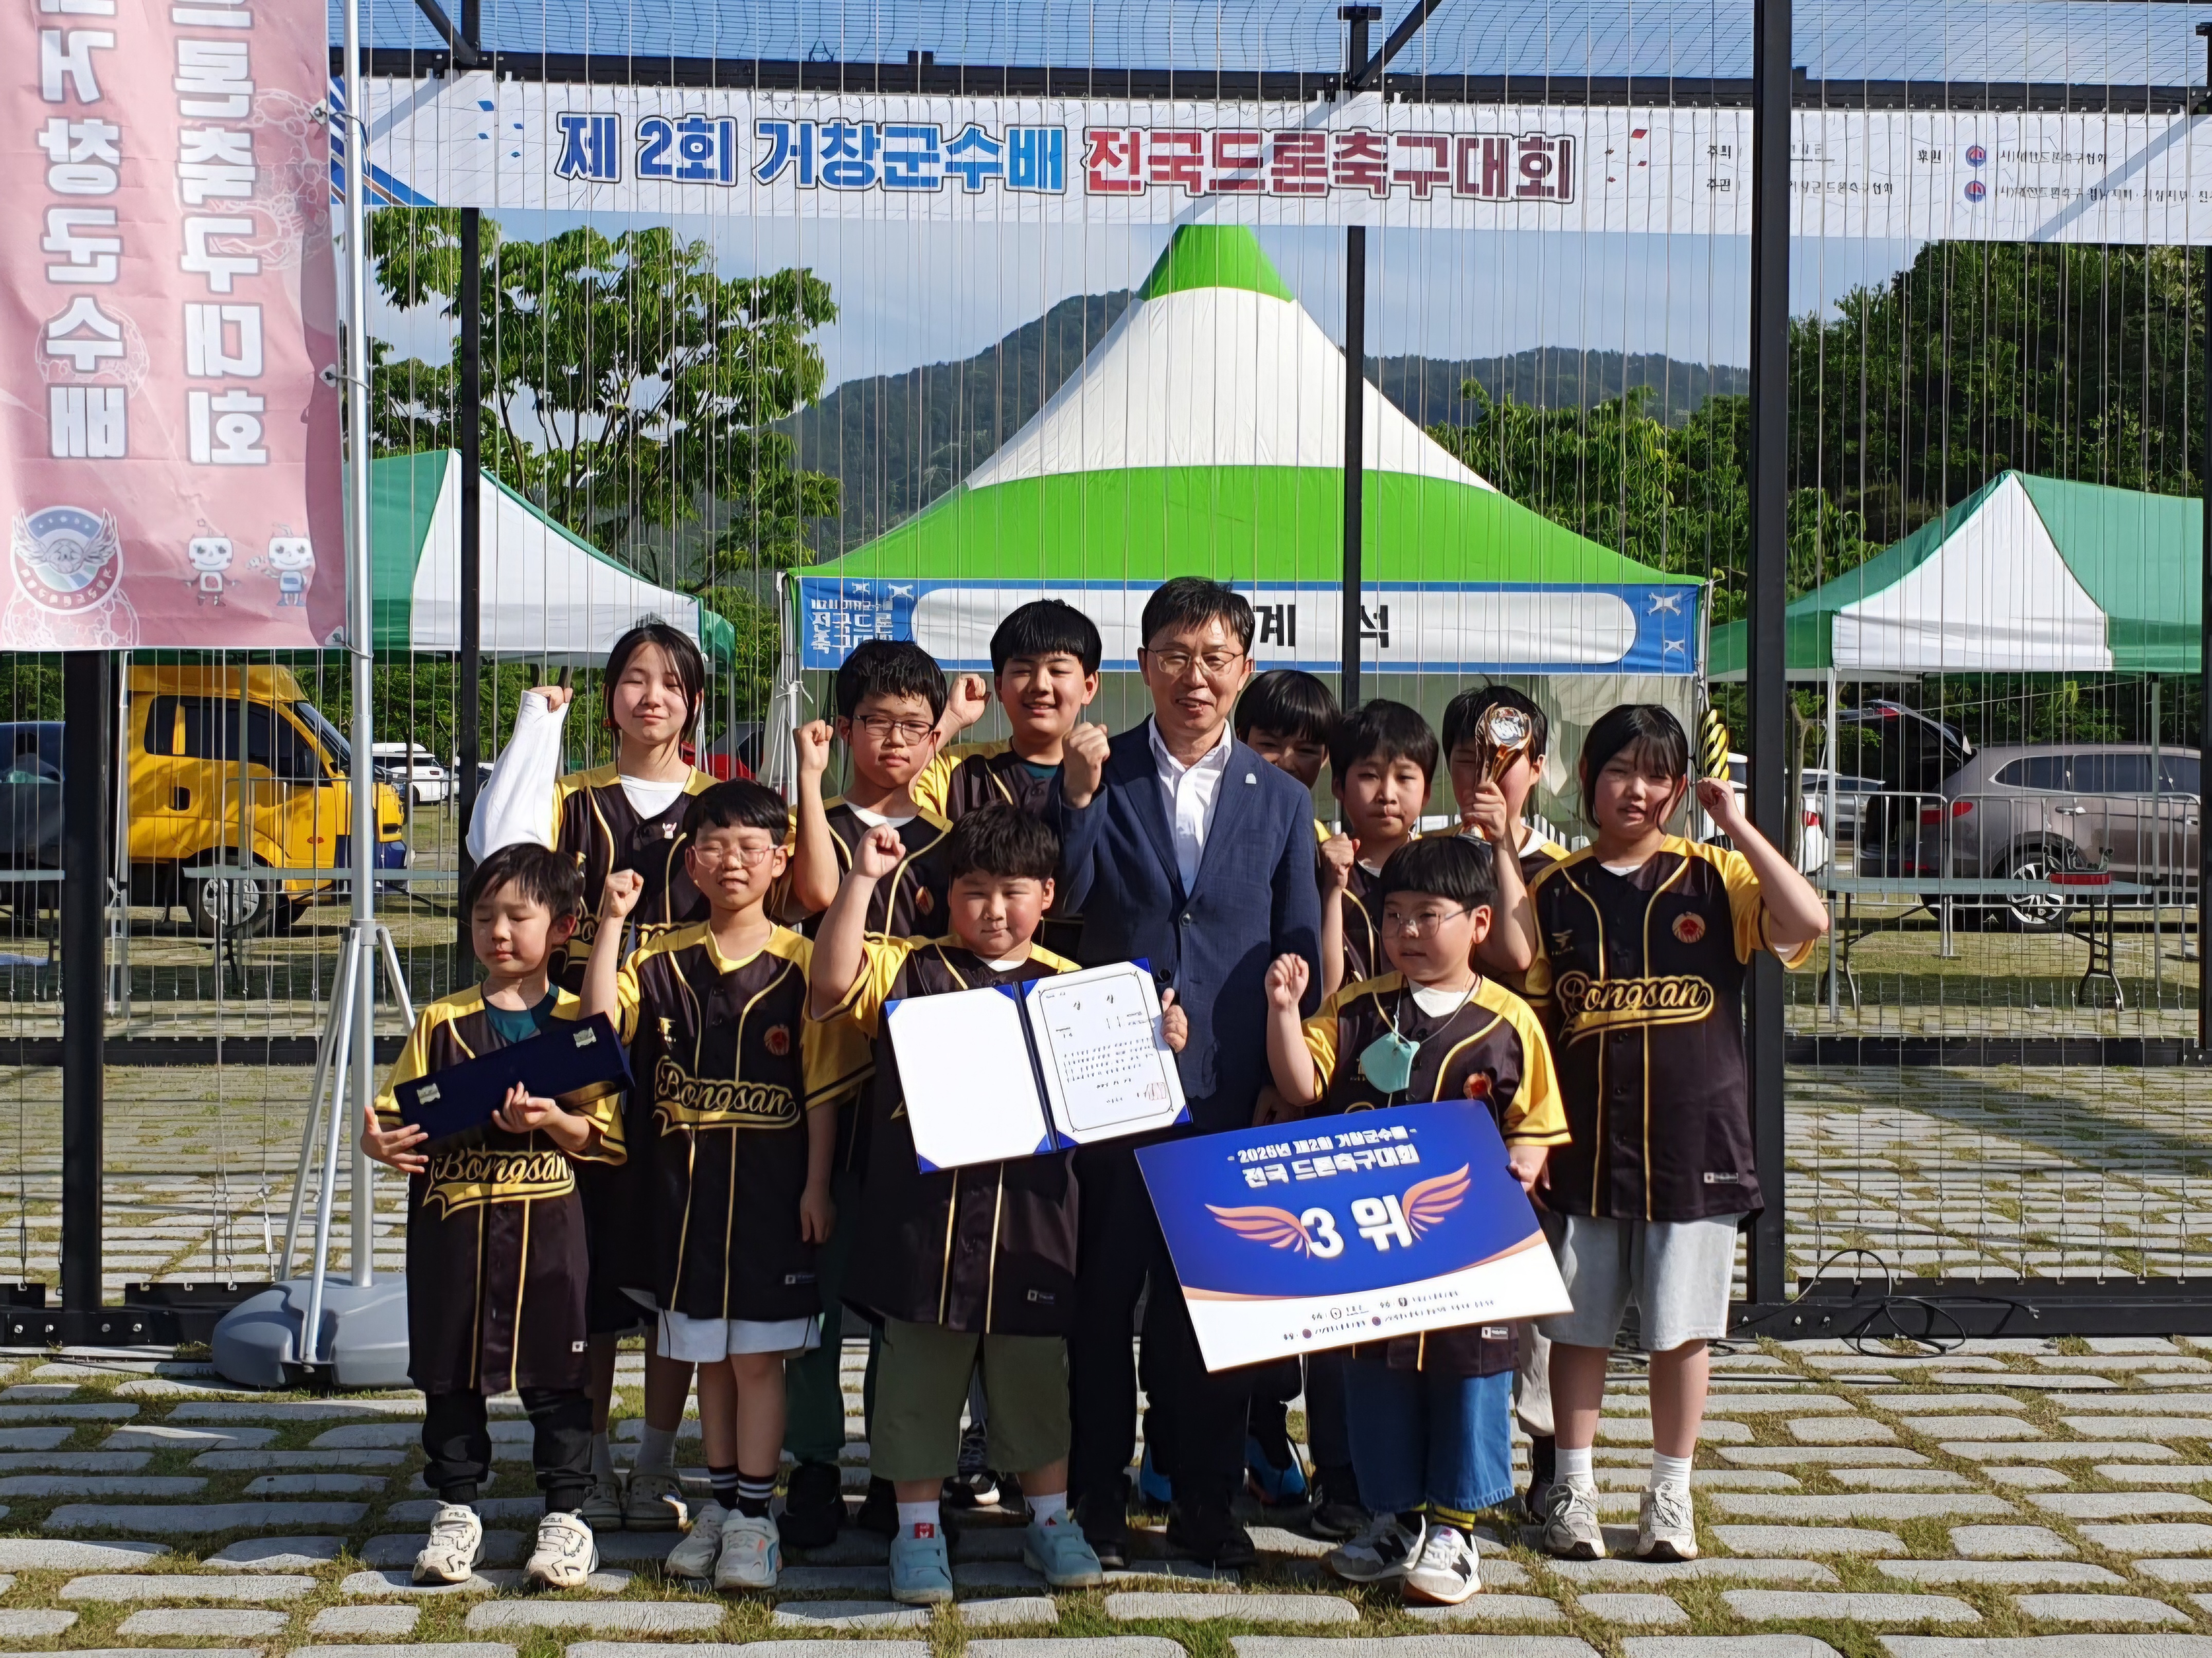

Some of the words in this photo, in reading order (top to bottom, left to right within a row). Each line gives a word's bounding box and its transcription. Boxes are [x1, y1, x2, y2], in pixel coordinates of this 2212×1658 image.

[555, 112, 621, 183] 제
[636, 113, 738, 187] 2회
[752, 118, 1067, 194] 거창군수배
[1082, 126, 1576, 204] 전국드론축구대회
[658, 1061, 796, 1115] Bongsan
[434, 1151, 569, 1185] Bongsan
[1242, 1163, 1290, 1188] 전국
[1299, 1206, 1345, 1258] 3
[1350, 1194, 1413, 1252] 위
